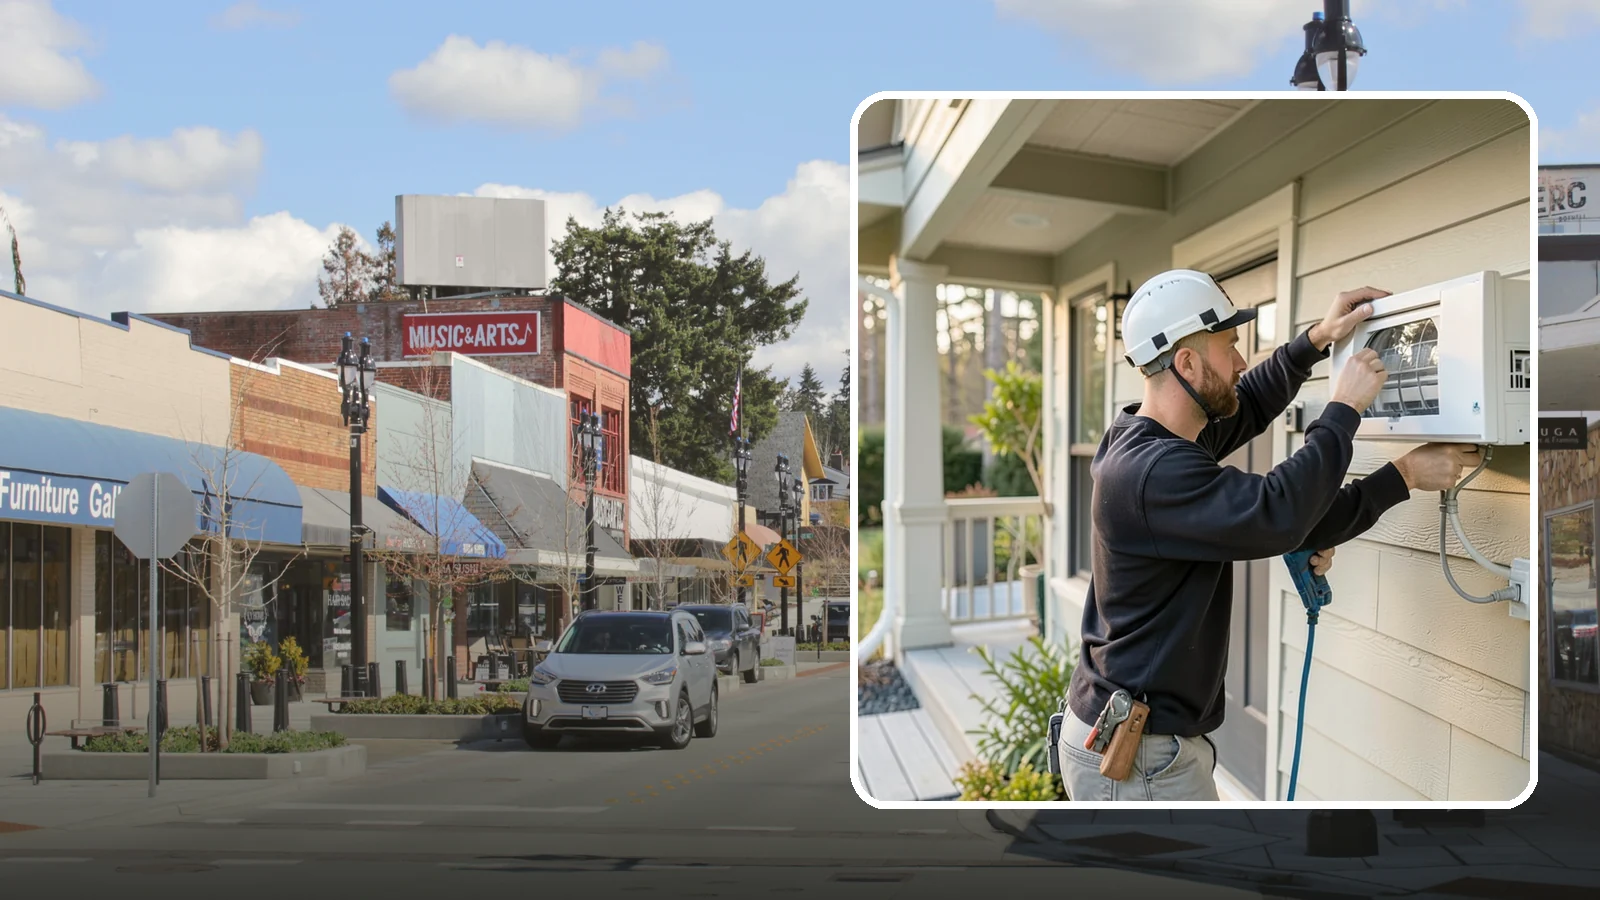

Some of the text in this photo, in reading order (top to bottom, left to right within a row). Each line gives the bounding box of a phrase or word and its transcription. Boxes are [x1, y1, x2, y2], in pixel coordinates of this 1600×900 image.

[408, 323, 520, 349] MUSIC&ARTS
[1540, 427, 1577, 437] UGA
[0, 471, 79, 516] Furniture
